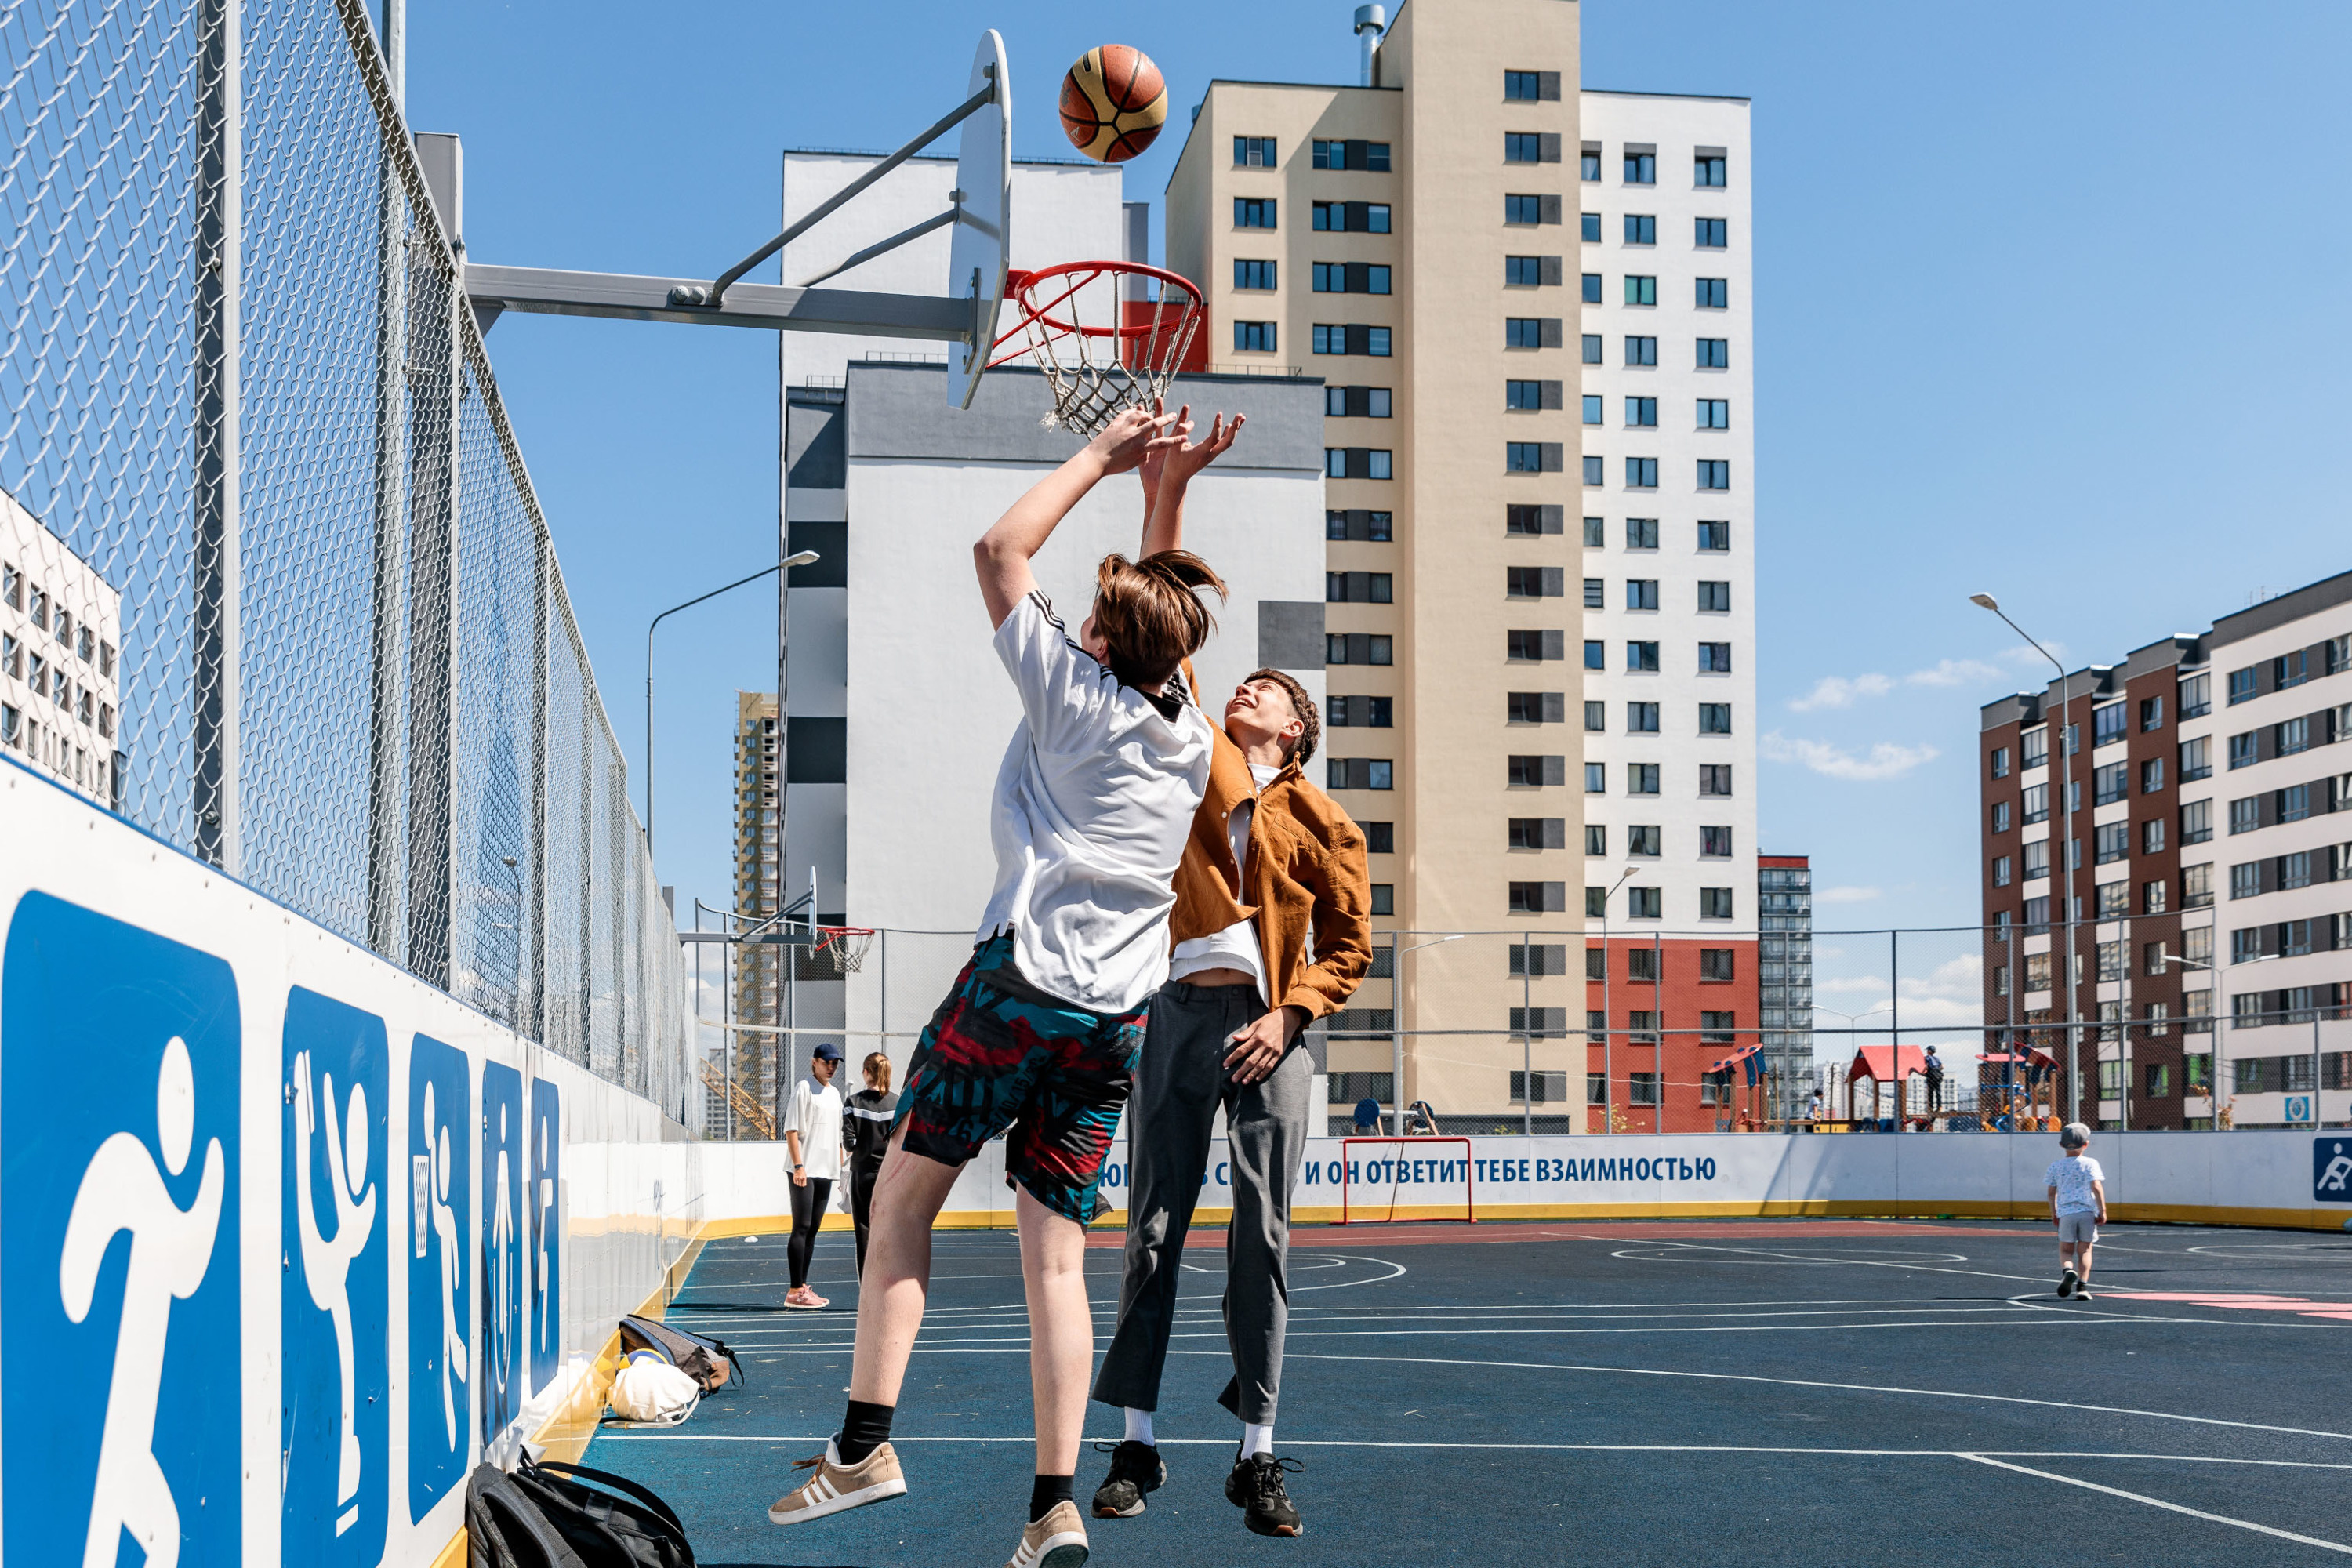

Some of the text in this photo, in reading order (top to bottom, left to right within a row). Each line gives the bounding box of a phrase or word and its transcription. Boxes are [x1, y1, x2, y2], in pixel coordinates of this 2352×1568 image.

[1305, 1157, 1716, 1185] И ОН ОТВЕТИТ ТЕБЕ ВЗАИМНОСТЬЮ
